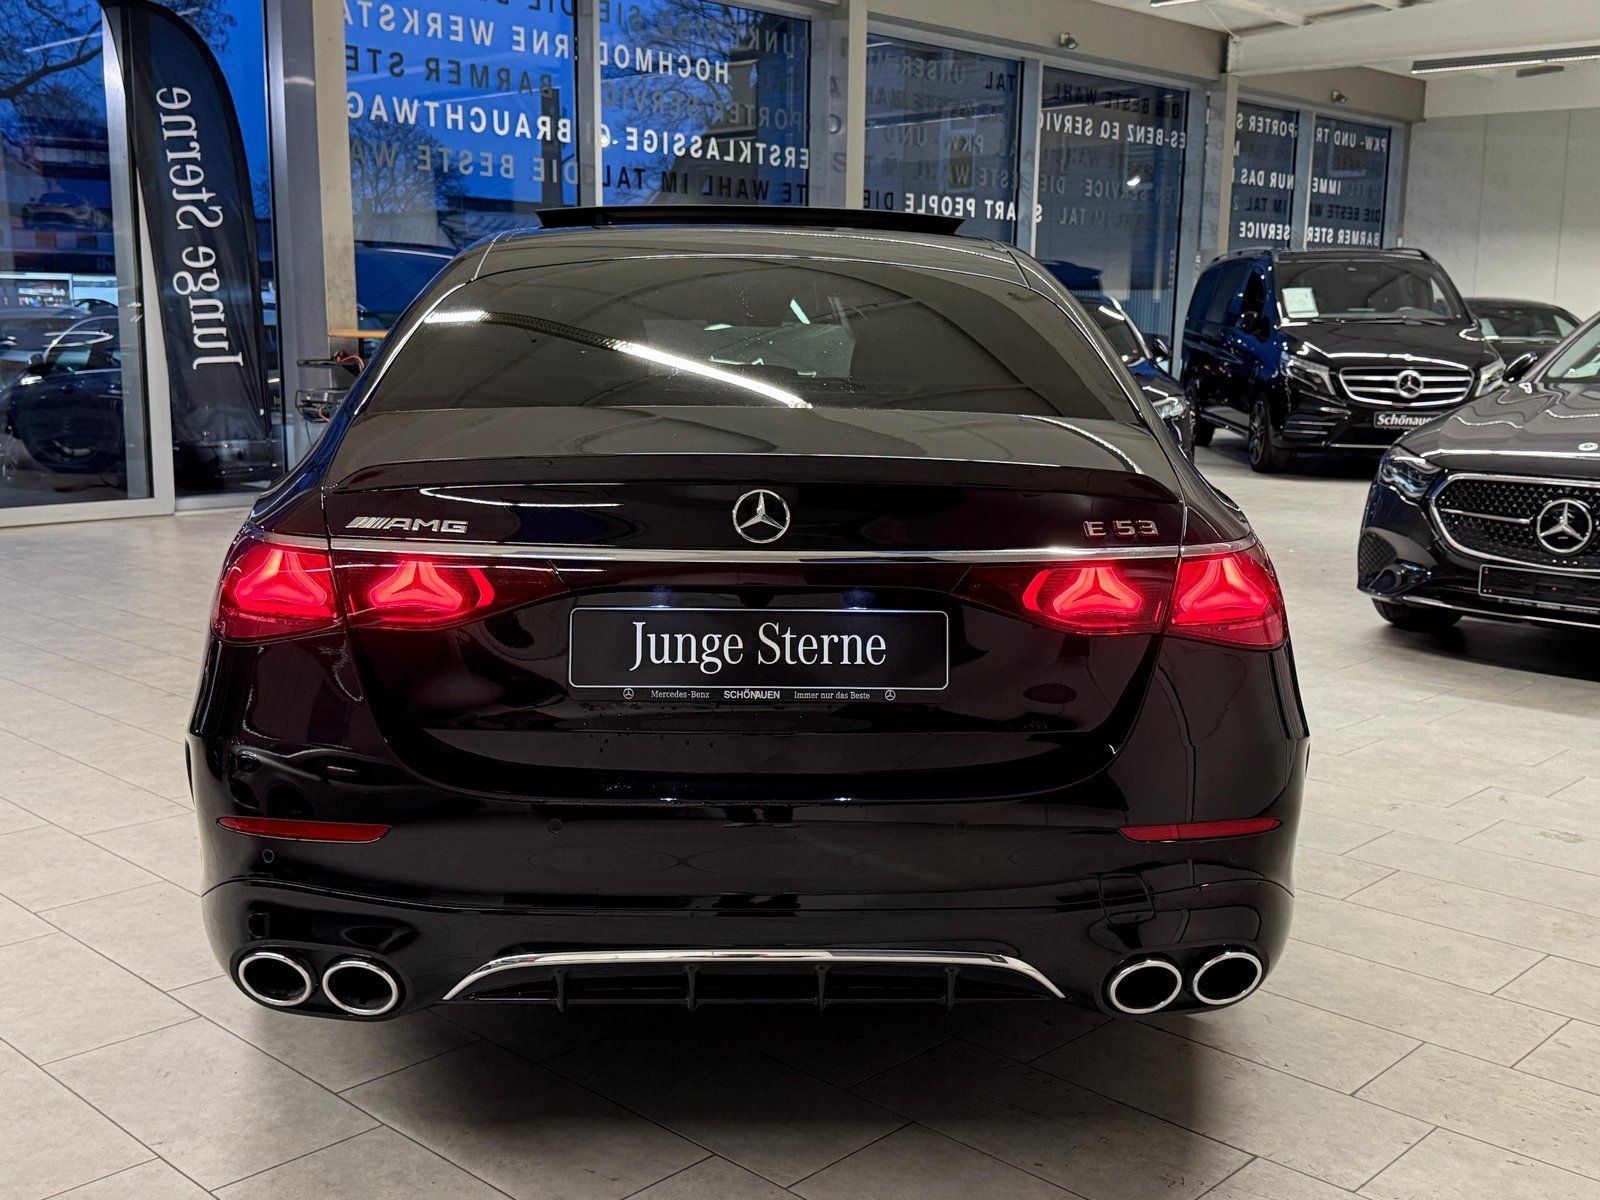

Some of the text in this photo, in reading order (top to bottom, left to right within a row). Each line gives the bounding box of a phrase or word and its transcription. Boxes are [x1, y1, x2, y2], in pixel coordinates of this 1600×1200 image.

[382, 517, 470, 534] AMG
[1082, 519, 1159, 538] E 53
[629, 621, 887, 674] Junge Sterne
[650, 688, 871, 700] Mercedes-Benz SCHÖNAUEN Immer nur das Beste
